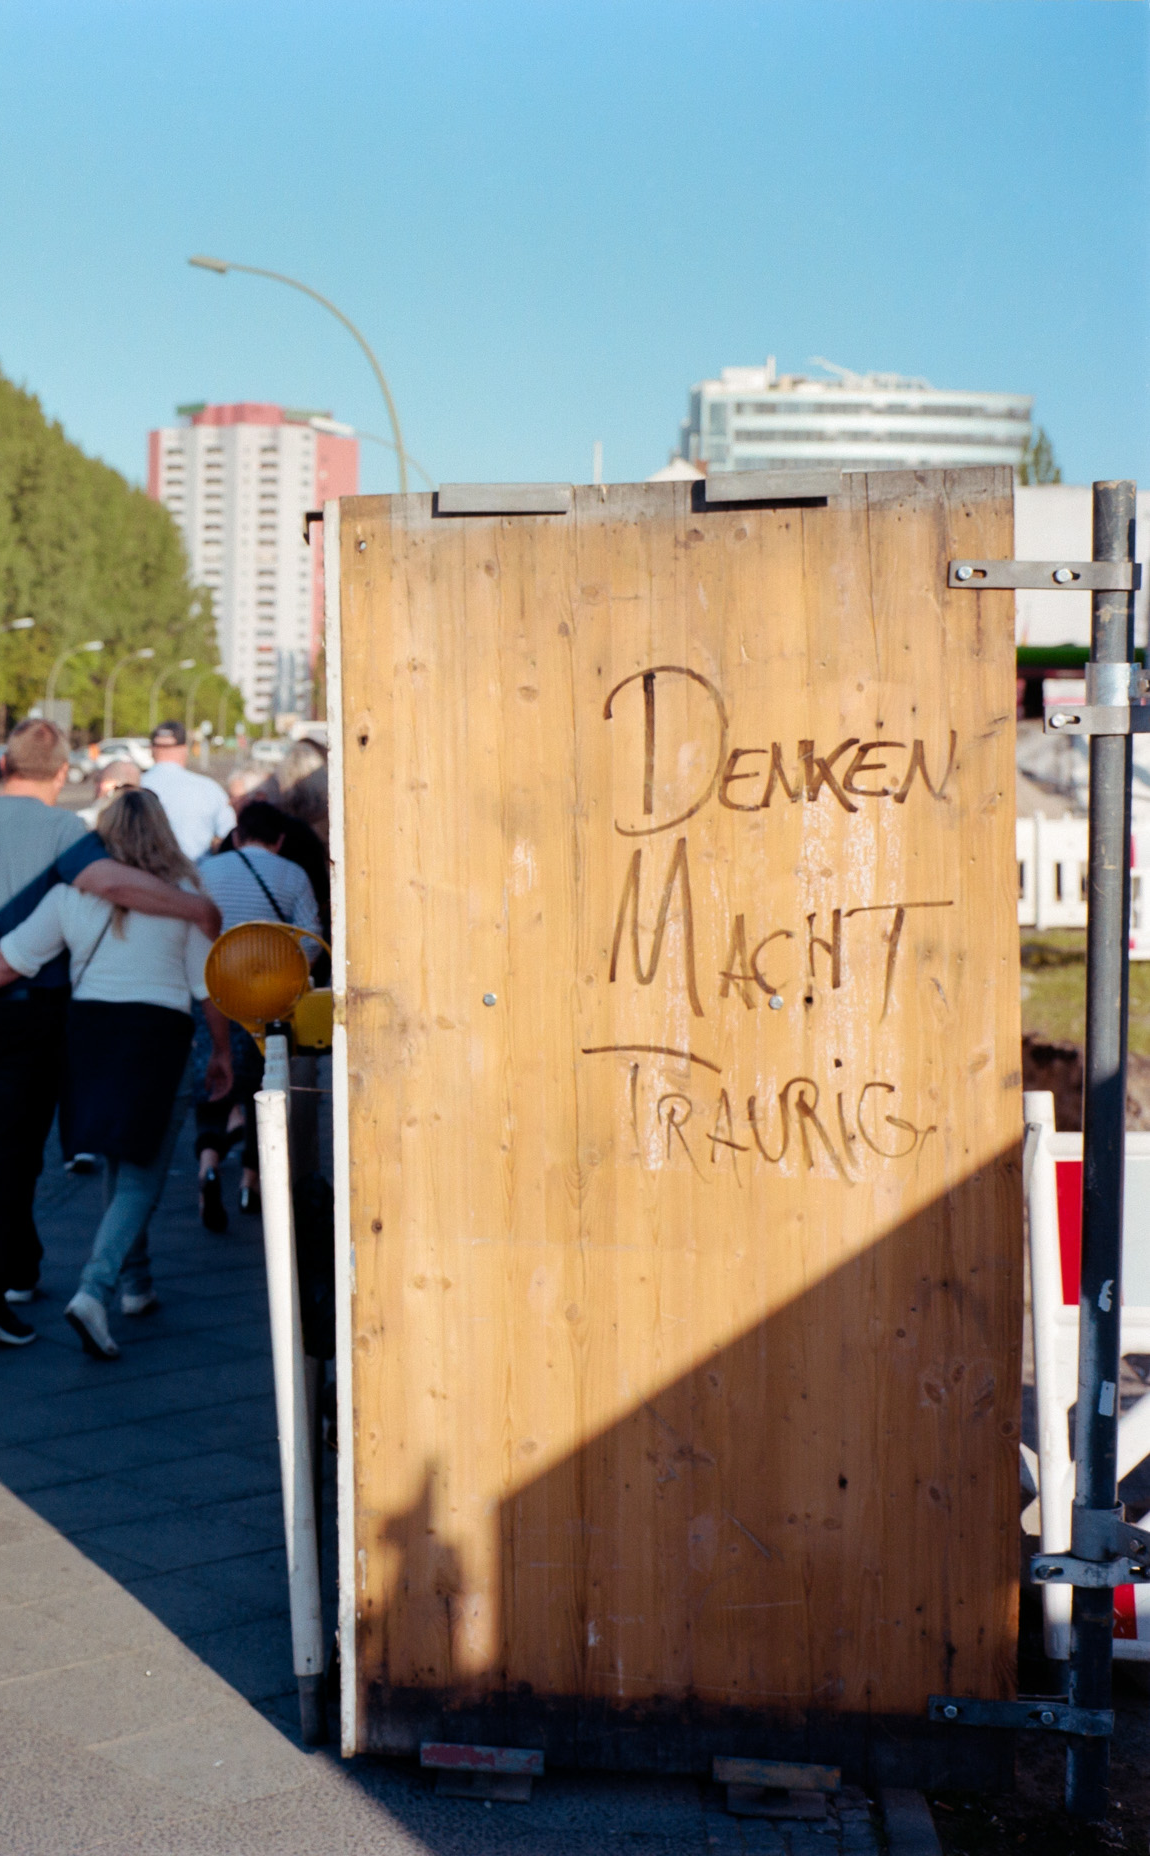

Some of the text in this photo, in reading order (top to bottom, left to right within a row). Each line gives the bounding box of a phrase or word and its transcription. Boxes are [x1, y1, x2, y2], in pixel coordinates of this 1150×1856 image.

[604, 665, 957, 836] DENKEN
[609, 837, 954, 1020] MACHT
[582, 1045, 938, 1187] TRAURIG
